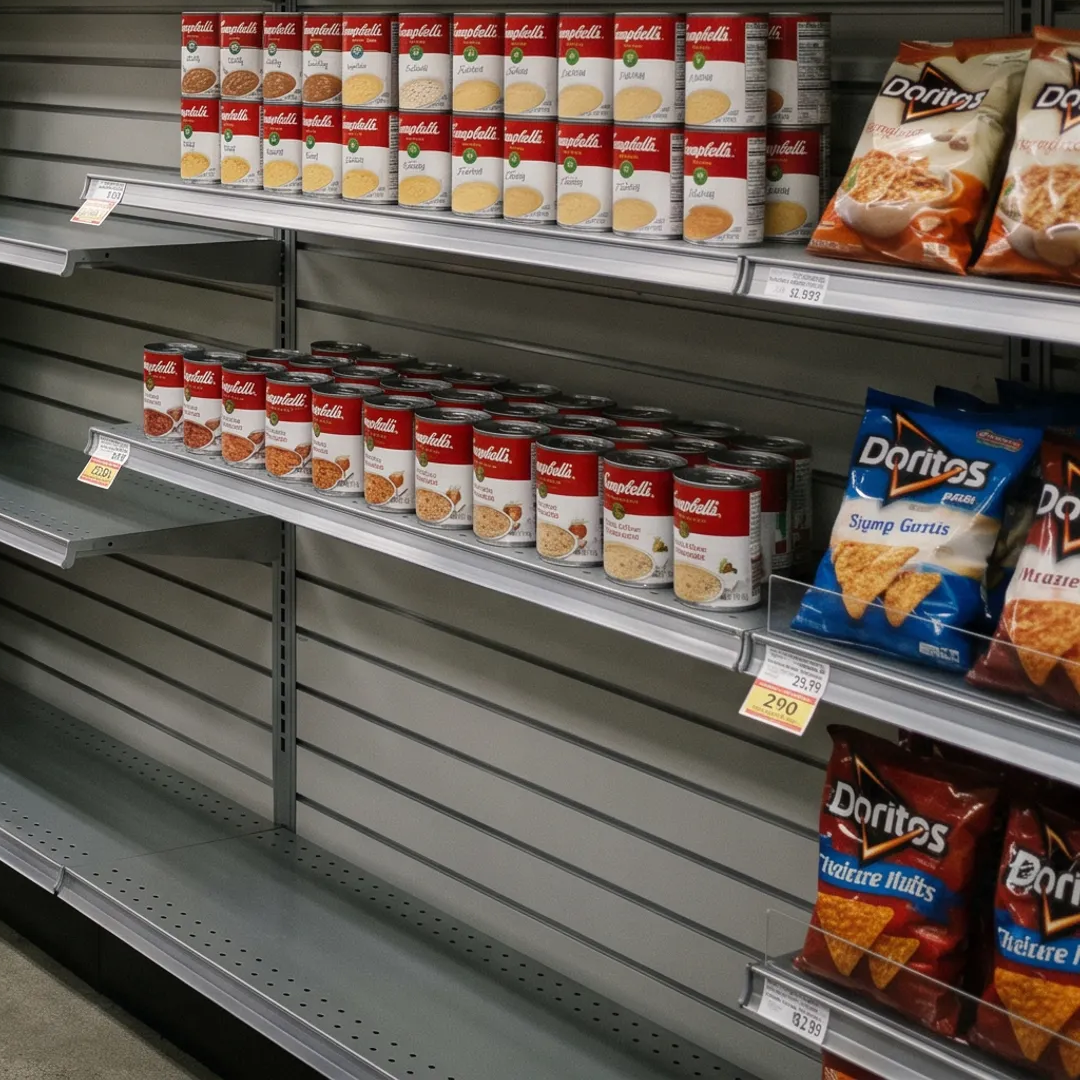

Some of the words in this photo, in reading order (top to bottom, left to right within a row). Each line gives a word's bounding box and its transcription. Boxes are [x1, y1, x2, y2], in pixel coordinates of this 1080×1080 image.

[883, 78, 988, 111] Doritos
[1036, 86, 1080, 109] Do
[859, 436, 991, 488] Doritos
[792, 675, 822, 694] 29.99
[763, 693, 798, 716] 290
[828, 780, 949, 855] Doritos
